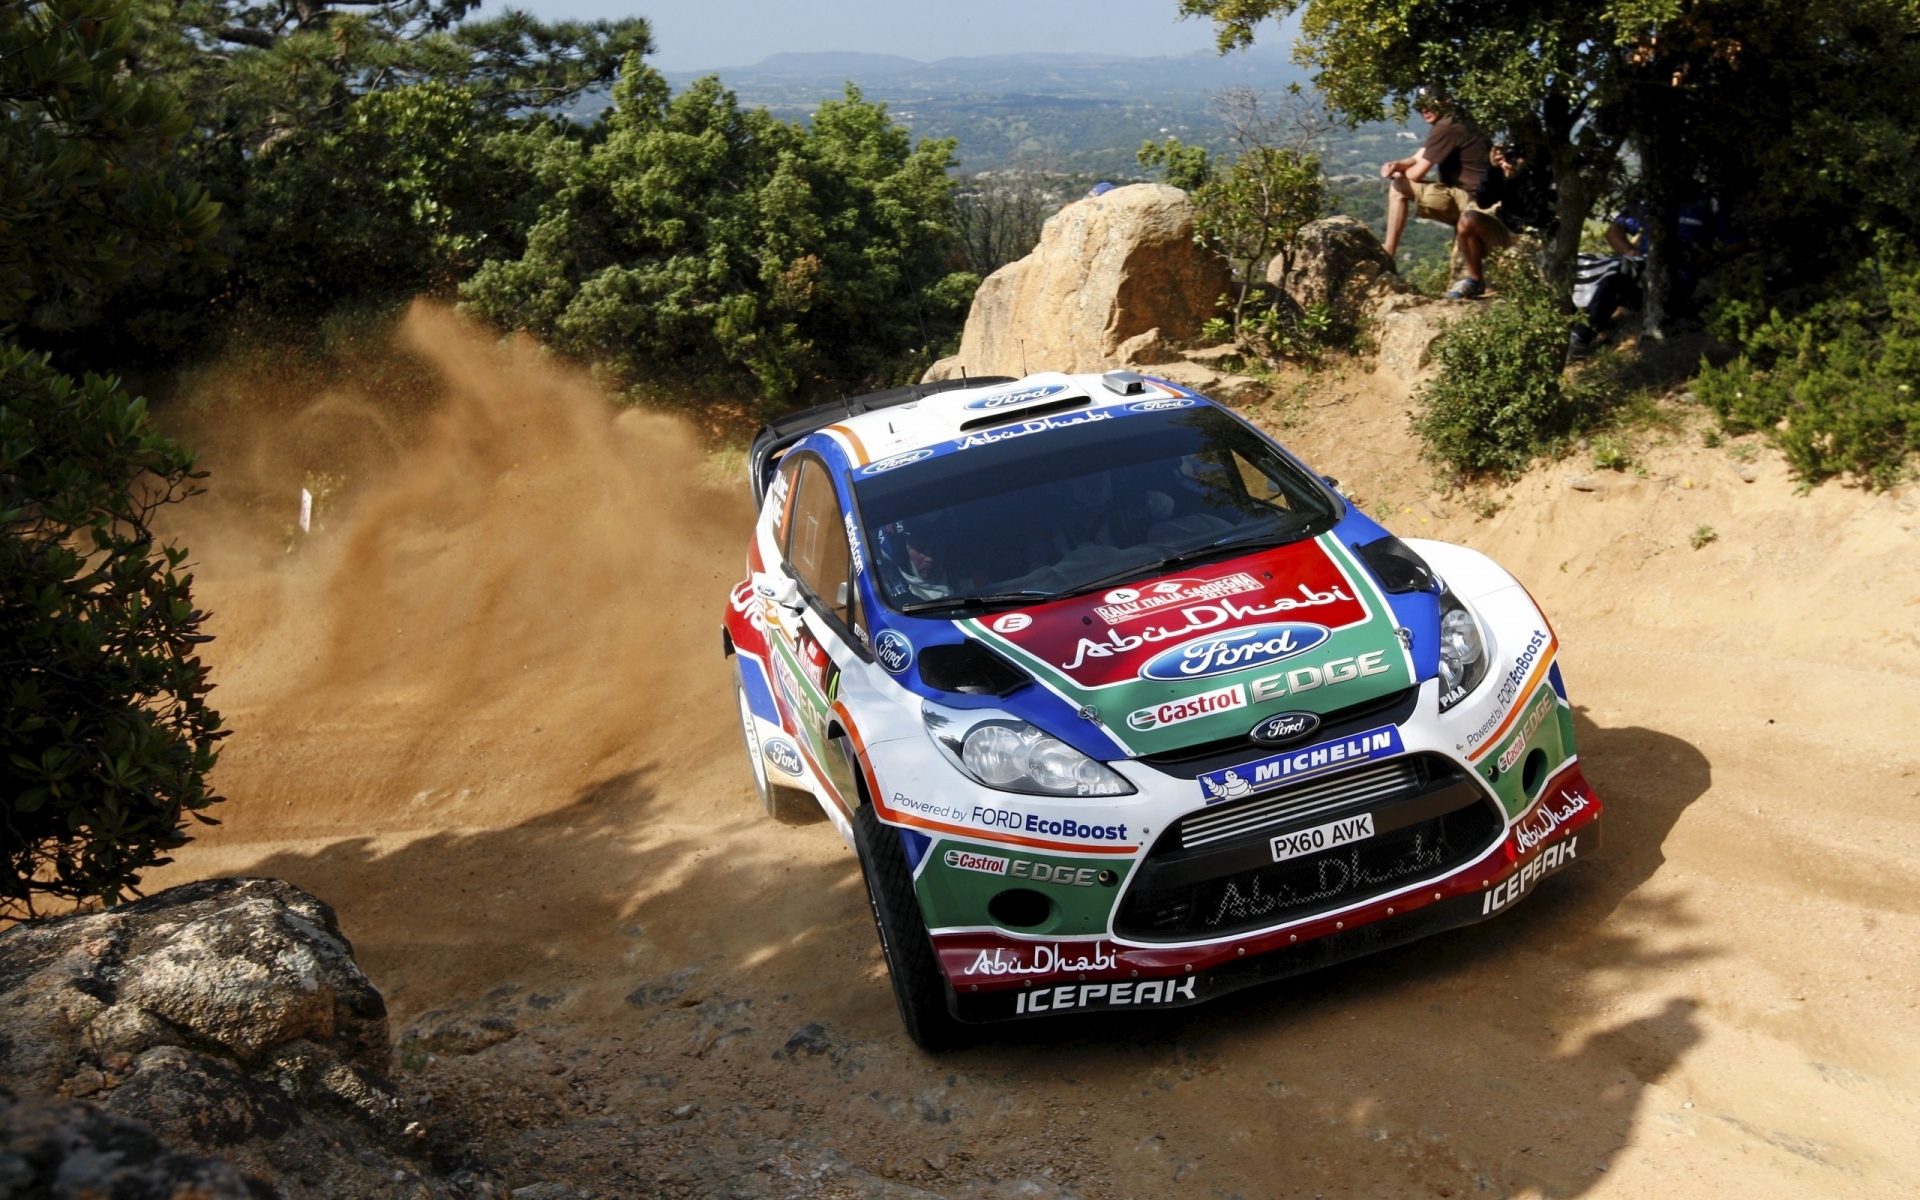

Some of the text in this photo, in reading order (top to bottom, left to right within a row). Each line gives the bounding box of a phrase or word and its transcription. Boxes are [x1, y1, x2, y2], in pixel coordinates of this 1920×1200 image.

[985, 385, 1051, 407] Ford
[1143, 399, 1185, 409] Ford
[876, 452, 920, 471] Ford
[1100, 601, 1141, 619] RALLY
[1139, 592, 1187, 609] ITALIA
[1182, 574, 1250, 598] SARDEGNA
[1116, 592, 1131, 600] 4
[1003, 617, 1023, 630] E
[878, 634, 907, 669] Ford
[1180, 631, 1299, 674] Ford
[1157, 650, 1392, 724] Castrol EDGE
[1439, 686, 1467, 708] PIAA
[1466, 715, 1498, 747] Powered
[1497, 677, 1518, 710] FORD
[1509, 629, 1547, 686] EcoBoost
[1266, 717, 1306, 739] Ford
[1505, 691, 1553, 766] Castrol EDGE
[769, 741, 799, 772] Ford
[1255, 731, 1391, 782] MICHELIN
[1077, 783, 1121, 796] PIAA
[893, 792, 1128, 841] Powered by FORD EcoBoost
[1274, 816, 1371, 858] PX60 AVK
[959, 852, 1098, 887] Castrol EDGE
[1482, 836, 1578, 915] ICEPEAK
[1016, 976, 1197, 1014] ICEPEAK
